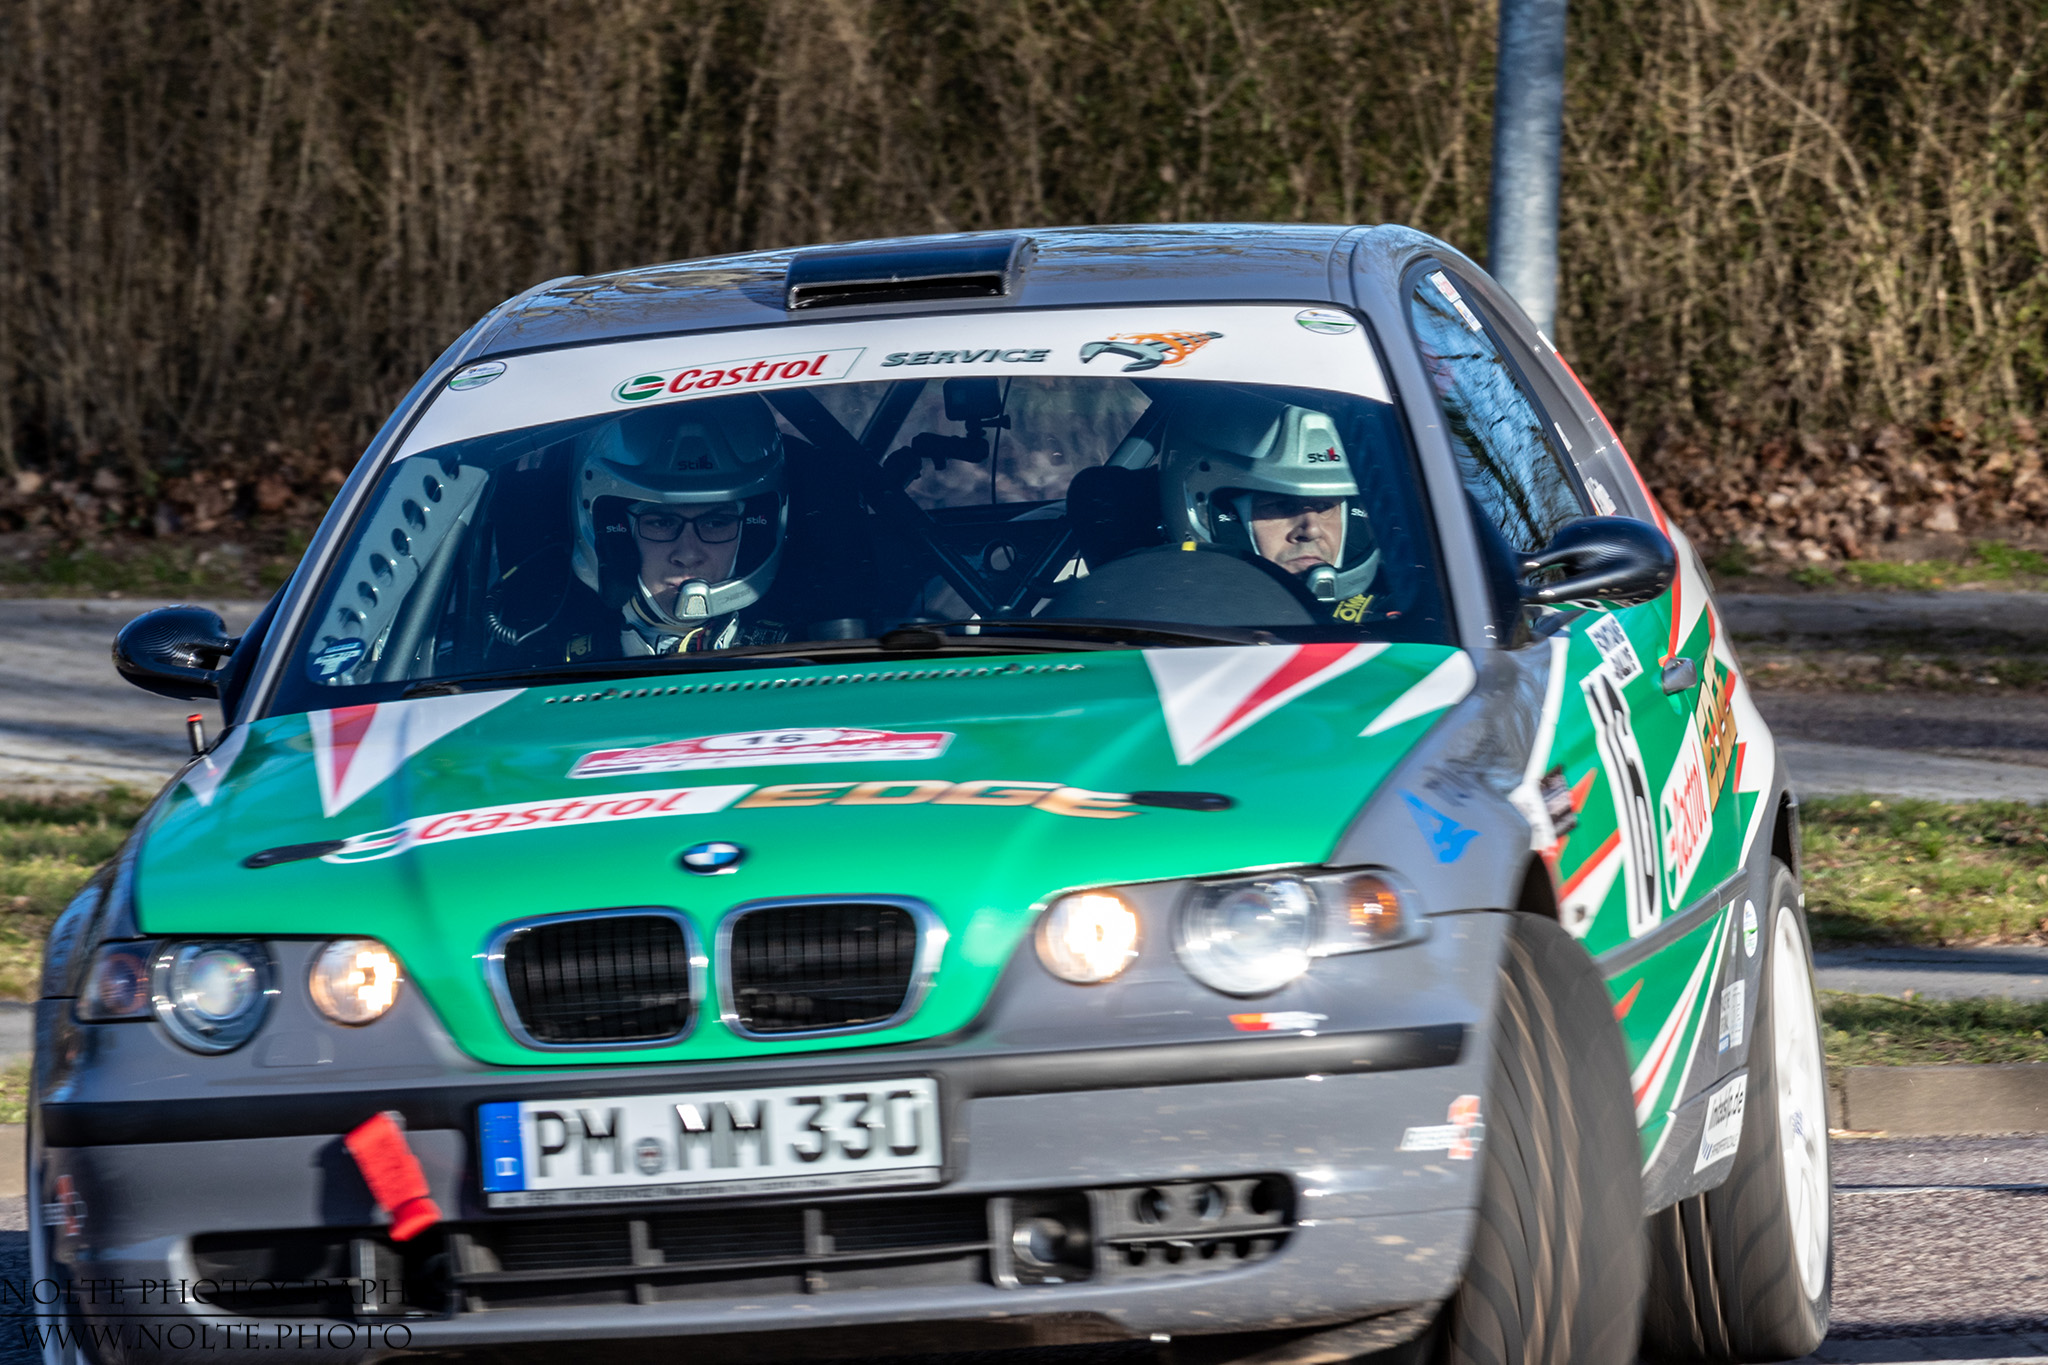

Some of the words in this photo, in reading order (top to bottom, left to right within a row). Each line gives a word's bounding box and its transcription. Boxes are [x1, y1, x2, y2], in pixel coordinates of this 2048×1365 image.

[668, 354, 829, 393] Castrol
[880, 349, 1052, 367] SERVICE
[738, 733, 804, 745] 16
[417, 790, 695, 841] Castrol
[734, 779, 1143, 820] EDGE
[534, 1107, 625, 1178] PM
[792, 1089, 923, 1163] 330
